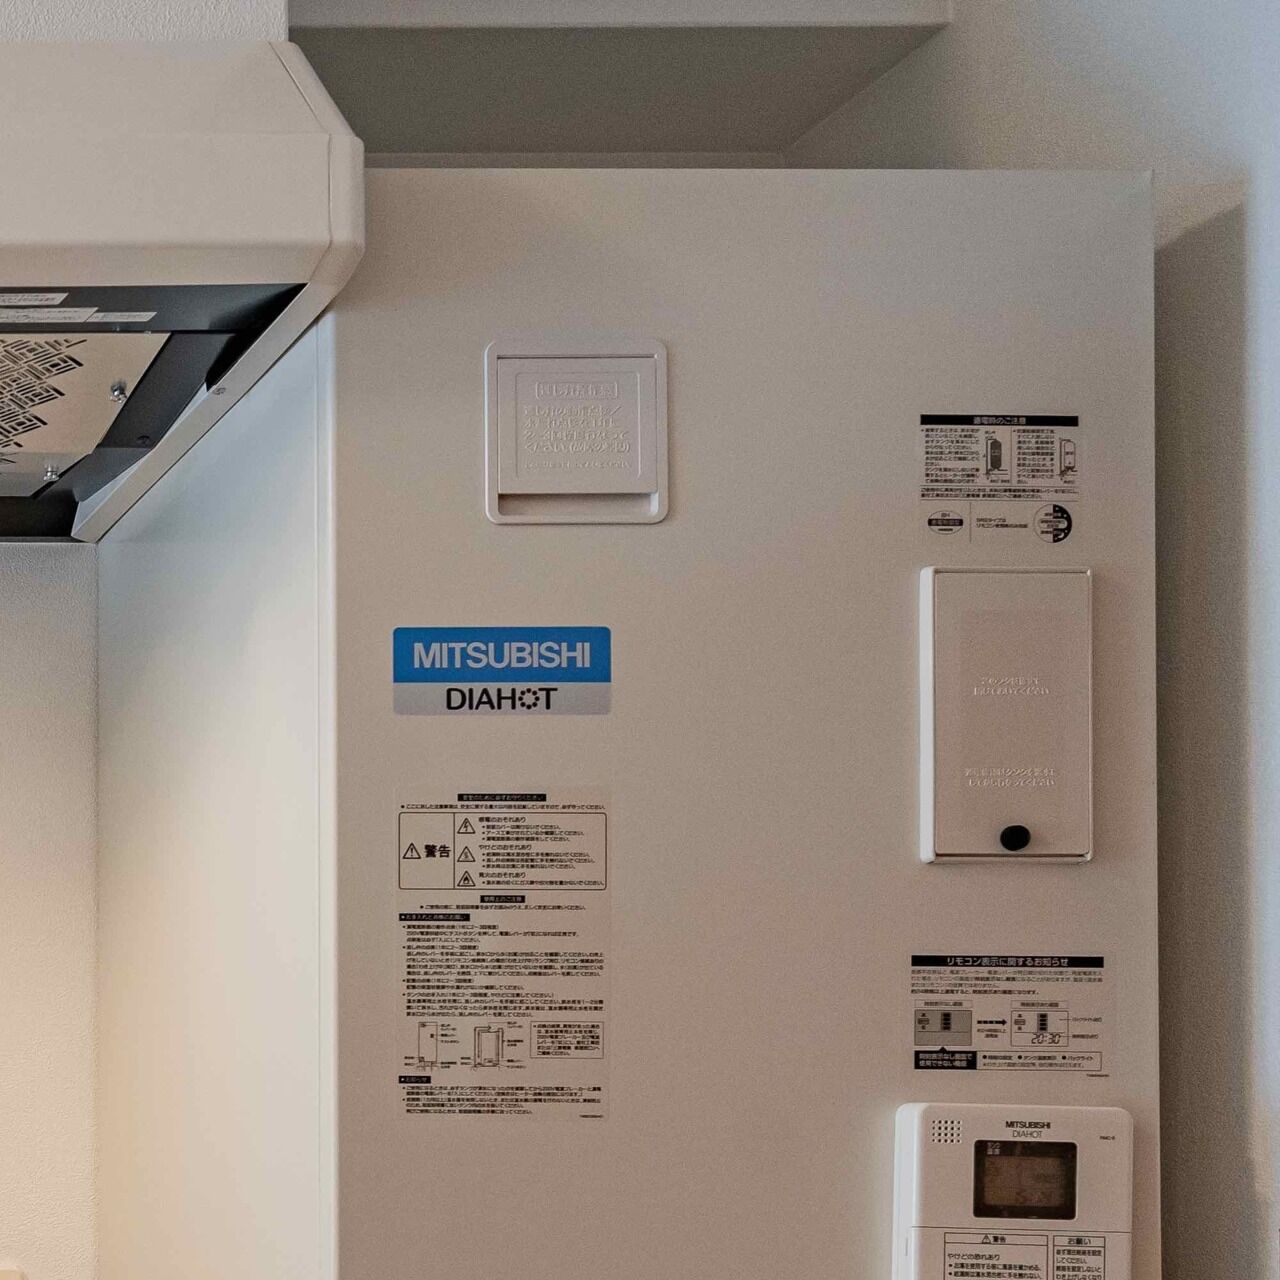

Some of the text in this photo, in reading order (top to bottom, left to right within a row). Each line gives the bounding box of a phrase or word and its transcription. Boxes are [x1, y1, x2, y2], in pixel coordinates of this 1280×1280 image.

[414, 642, 590, 668] MITSUBISHI
[446, 688, 558, 710] DIAHOT
[424, 844, 450, 858] 警告
[947, 957, 1069, 967] リモコン表示に関するお知らせ
[1031, 1034, 1061, 1044] 20:30
[1006, 1121, 1051, 1129] MITSUBISHI
[1012, 1130, 1043, 1138] DIAHOT
